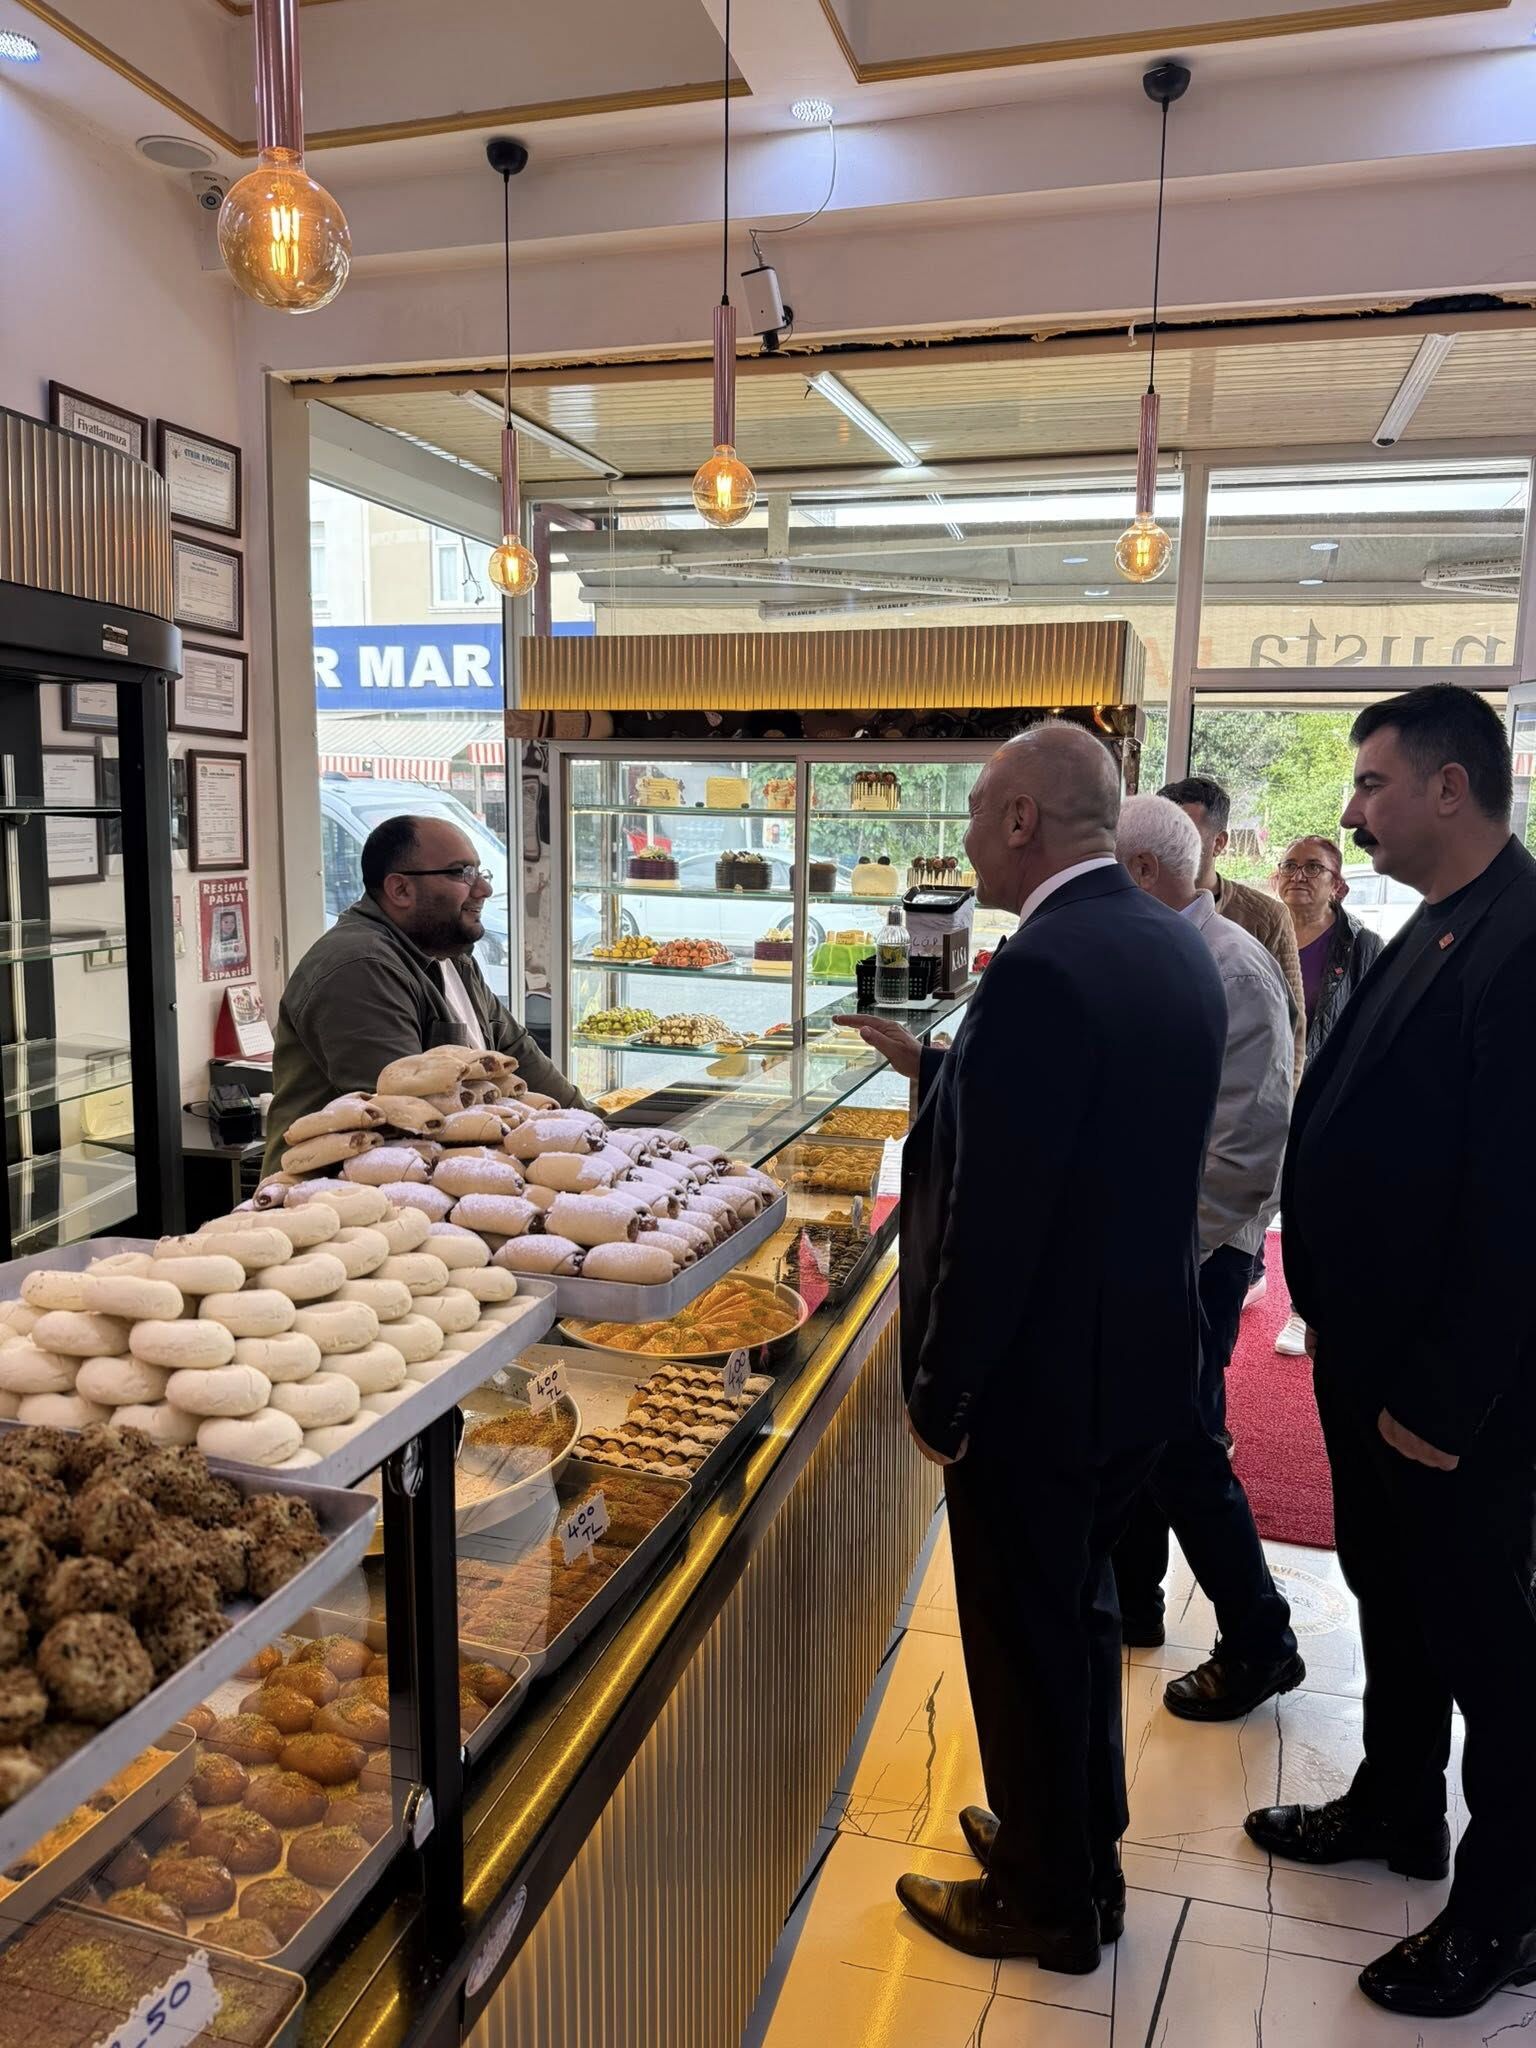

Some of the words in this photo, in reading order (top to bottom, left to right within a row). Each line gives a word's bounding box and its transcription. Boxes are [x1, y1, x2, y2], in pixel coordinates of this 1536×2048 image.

[359, 643, 504, 688] MAR
[209, 892, 244, 906] PASTA
[536, 1370, 558, 1396] 400
[546, 1385, 562, 1400] TL
[567, 1505, 595, 1539] 400
[581, 1522, 603, 1541] TL
